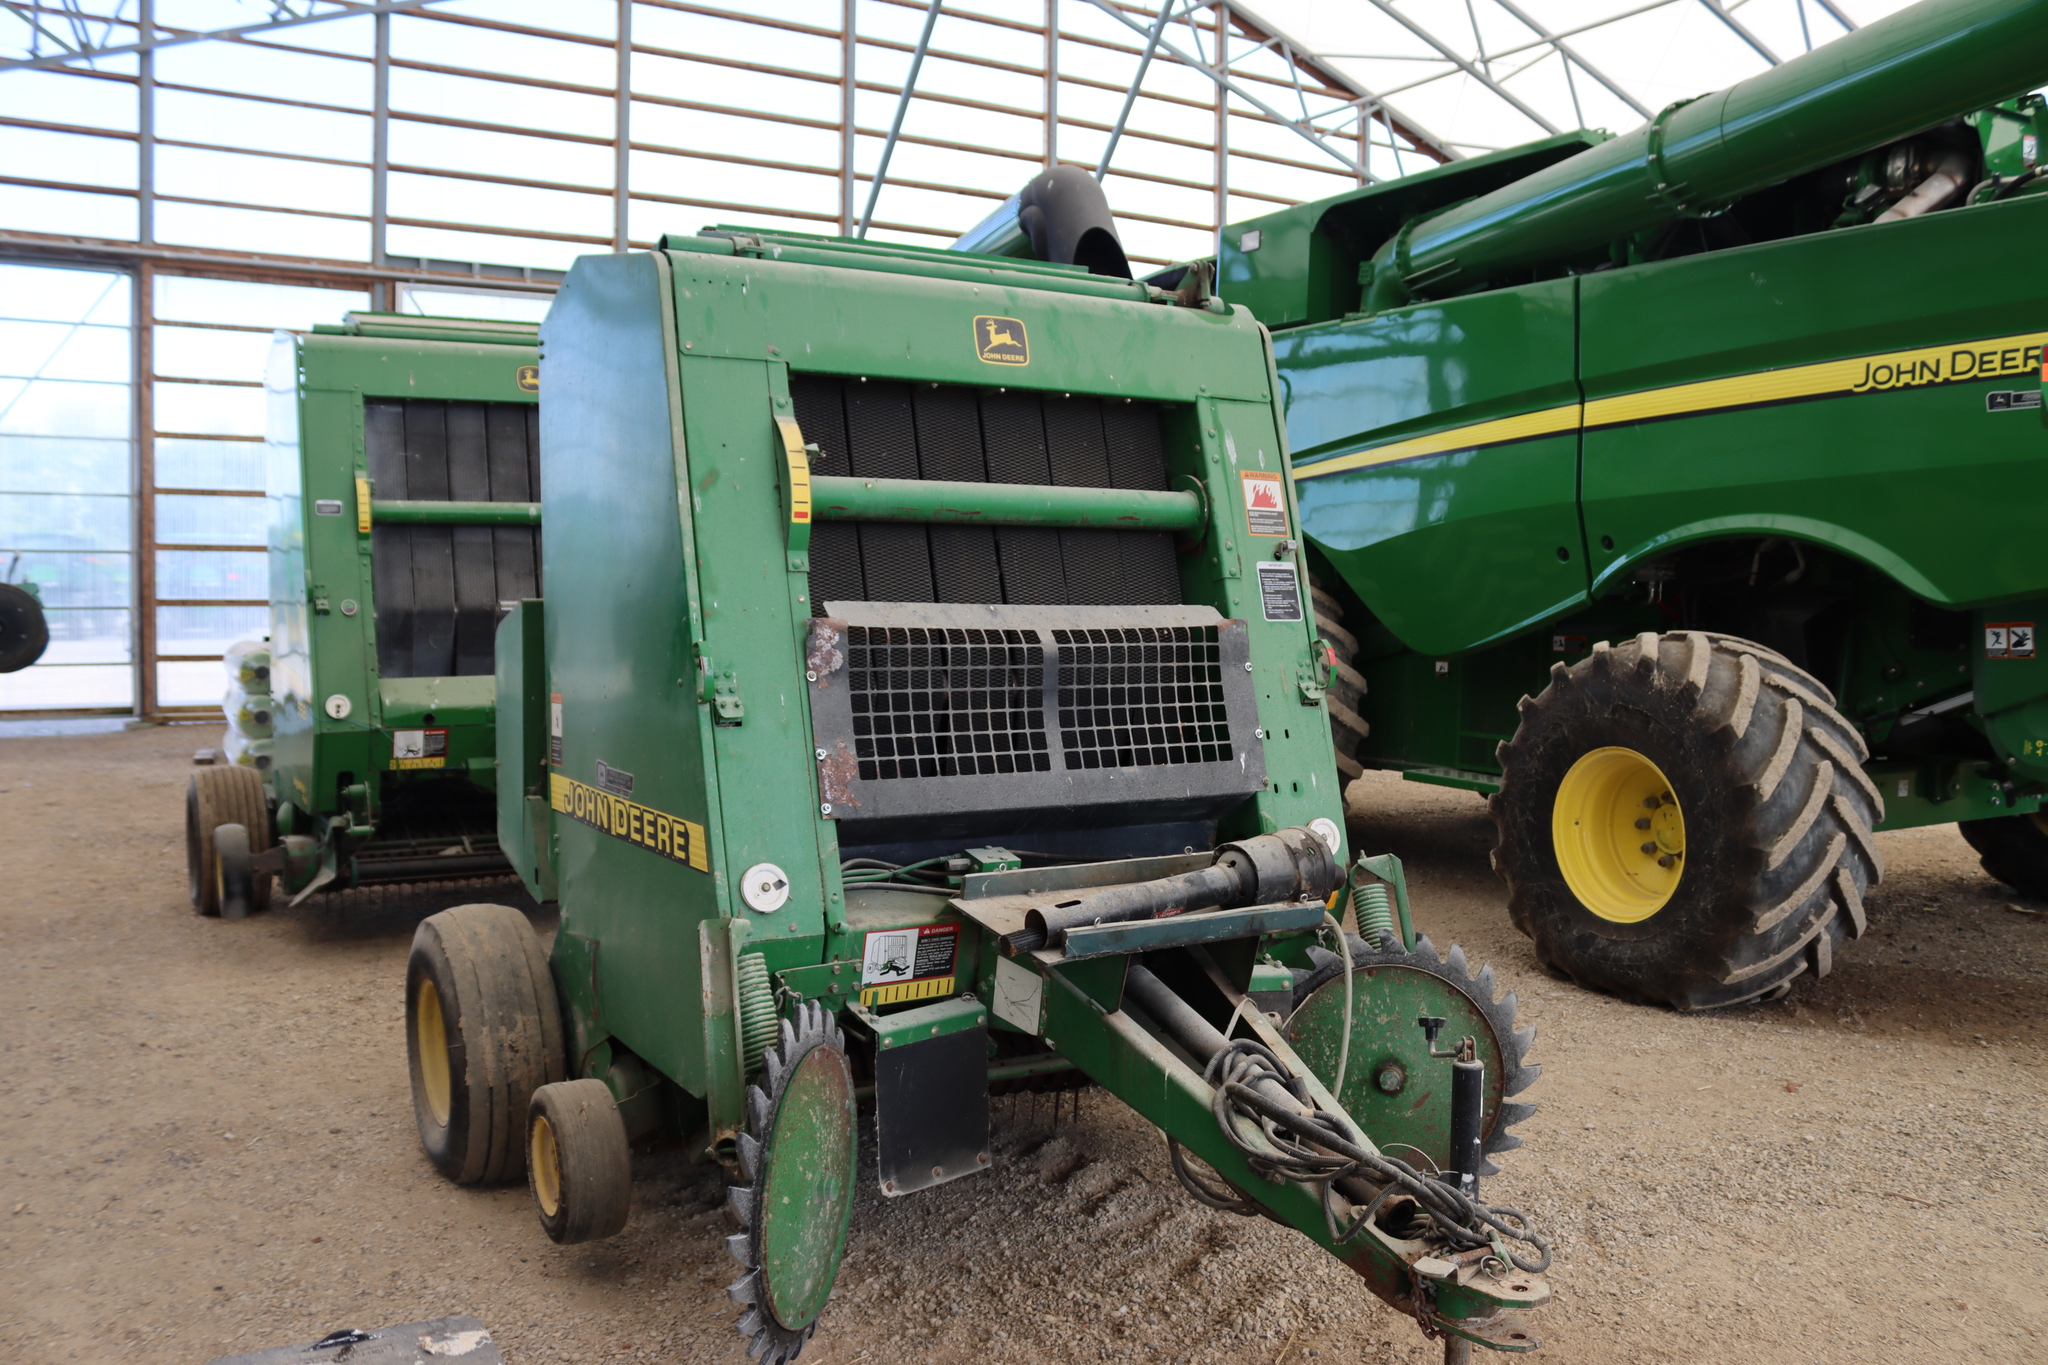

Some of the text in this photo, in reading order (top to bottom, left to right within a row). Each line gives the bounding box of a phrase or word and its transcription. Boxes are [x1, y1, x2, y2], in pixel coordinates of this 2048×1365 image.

[982, 352, 1025, 362] JOHN DEERE
[1853, 346, 2042, 388] JOHN DEER
[1249, 472, 1278, 480] WARNING
[564, 782, 688, 860] JOHN DEERE
[931, 926, 954, 934] DANGER
